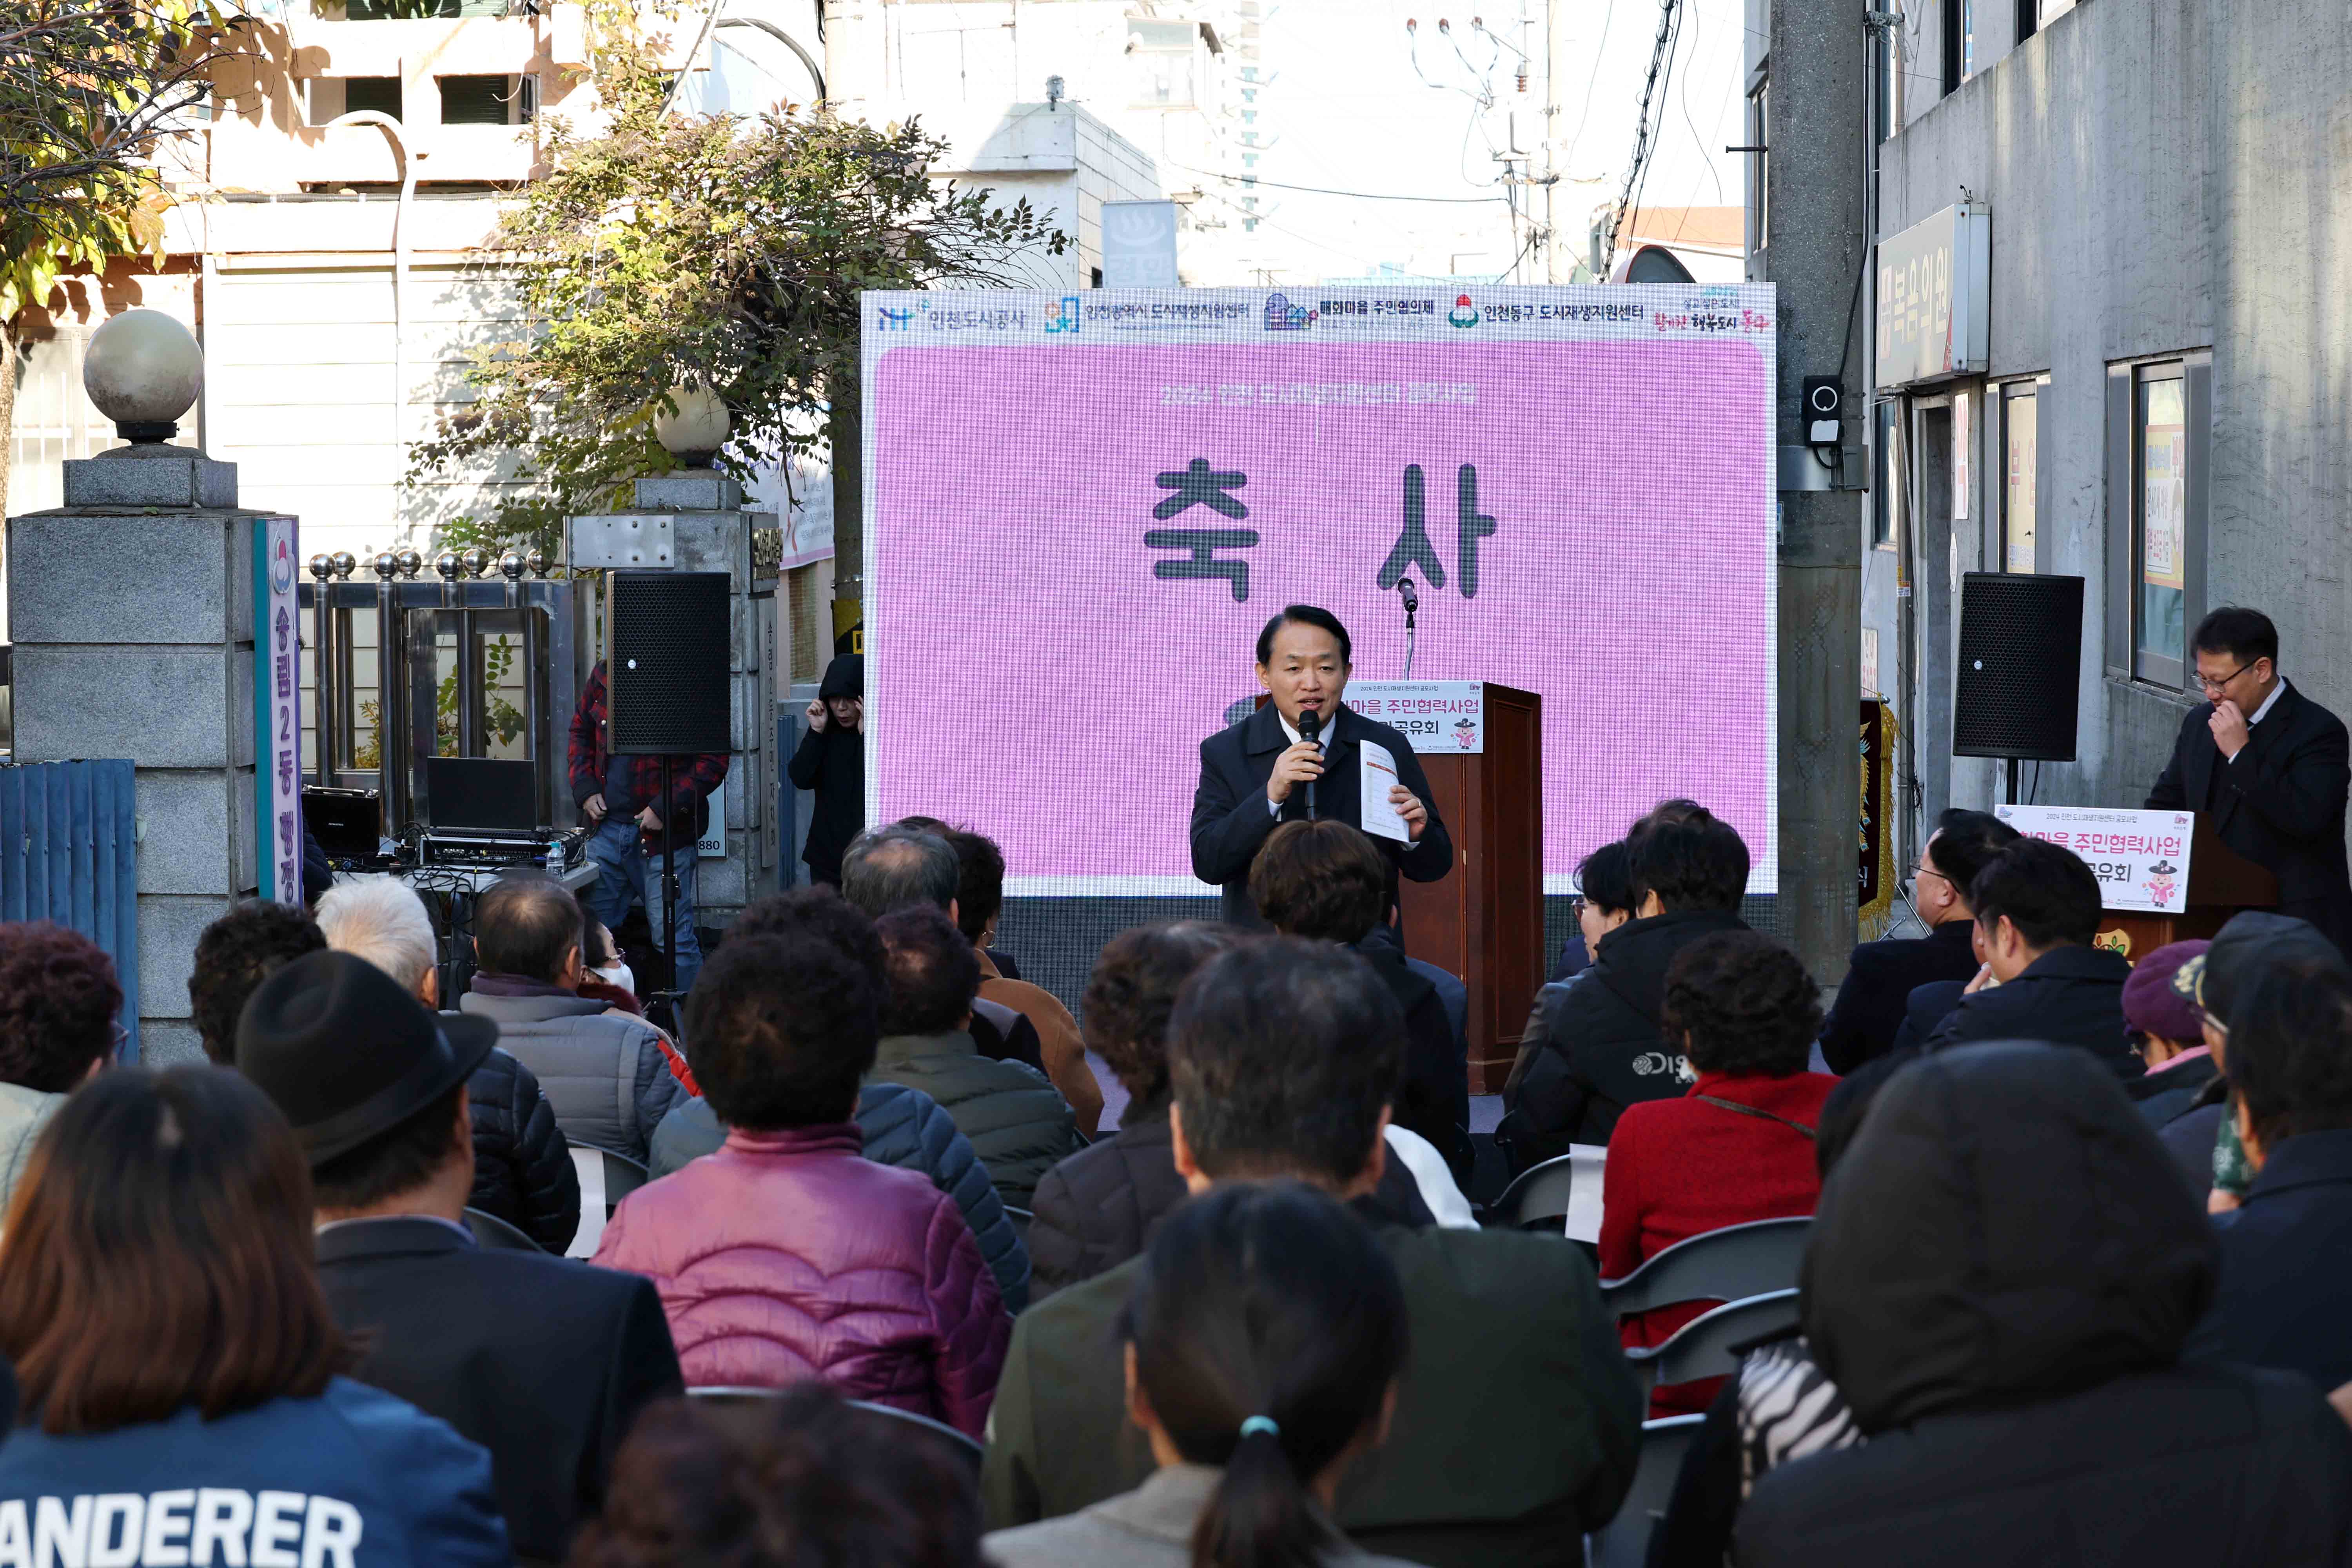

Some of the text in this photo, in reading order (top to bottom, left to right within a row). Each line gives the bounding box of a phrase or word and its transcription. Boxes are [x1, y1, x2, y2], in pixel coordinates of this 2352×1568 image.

[1085, 303, 1249, 320] 인천광역시 도시재생지원센터
[1320, 300, 1434, 314] 매화마을 주민협의체
[1484, 304, 1644, 322] 인천동구 도시재생지원센터
[930, 310, 1027, 330] 인천도시공사
[1691, 312, 1737, 333] 행복도시
[1738, 309, 1770, 334] 동구
[1160, 382, 1476, 405] 2024 인천 도시재생지원센터 공모사업
[1143, 457, 1497, 603] 축 사
[1387, 699, 1479, 715] 주민협력사업
[2072, 814, 2114, 822] 도시재생지원센터
[2115, 815, 2138, 823] 공모사업
[699, 840, 720, 850] 880
[2074, 832, 2181, 857] 주민협력사업
